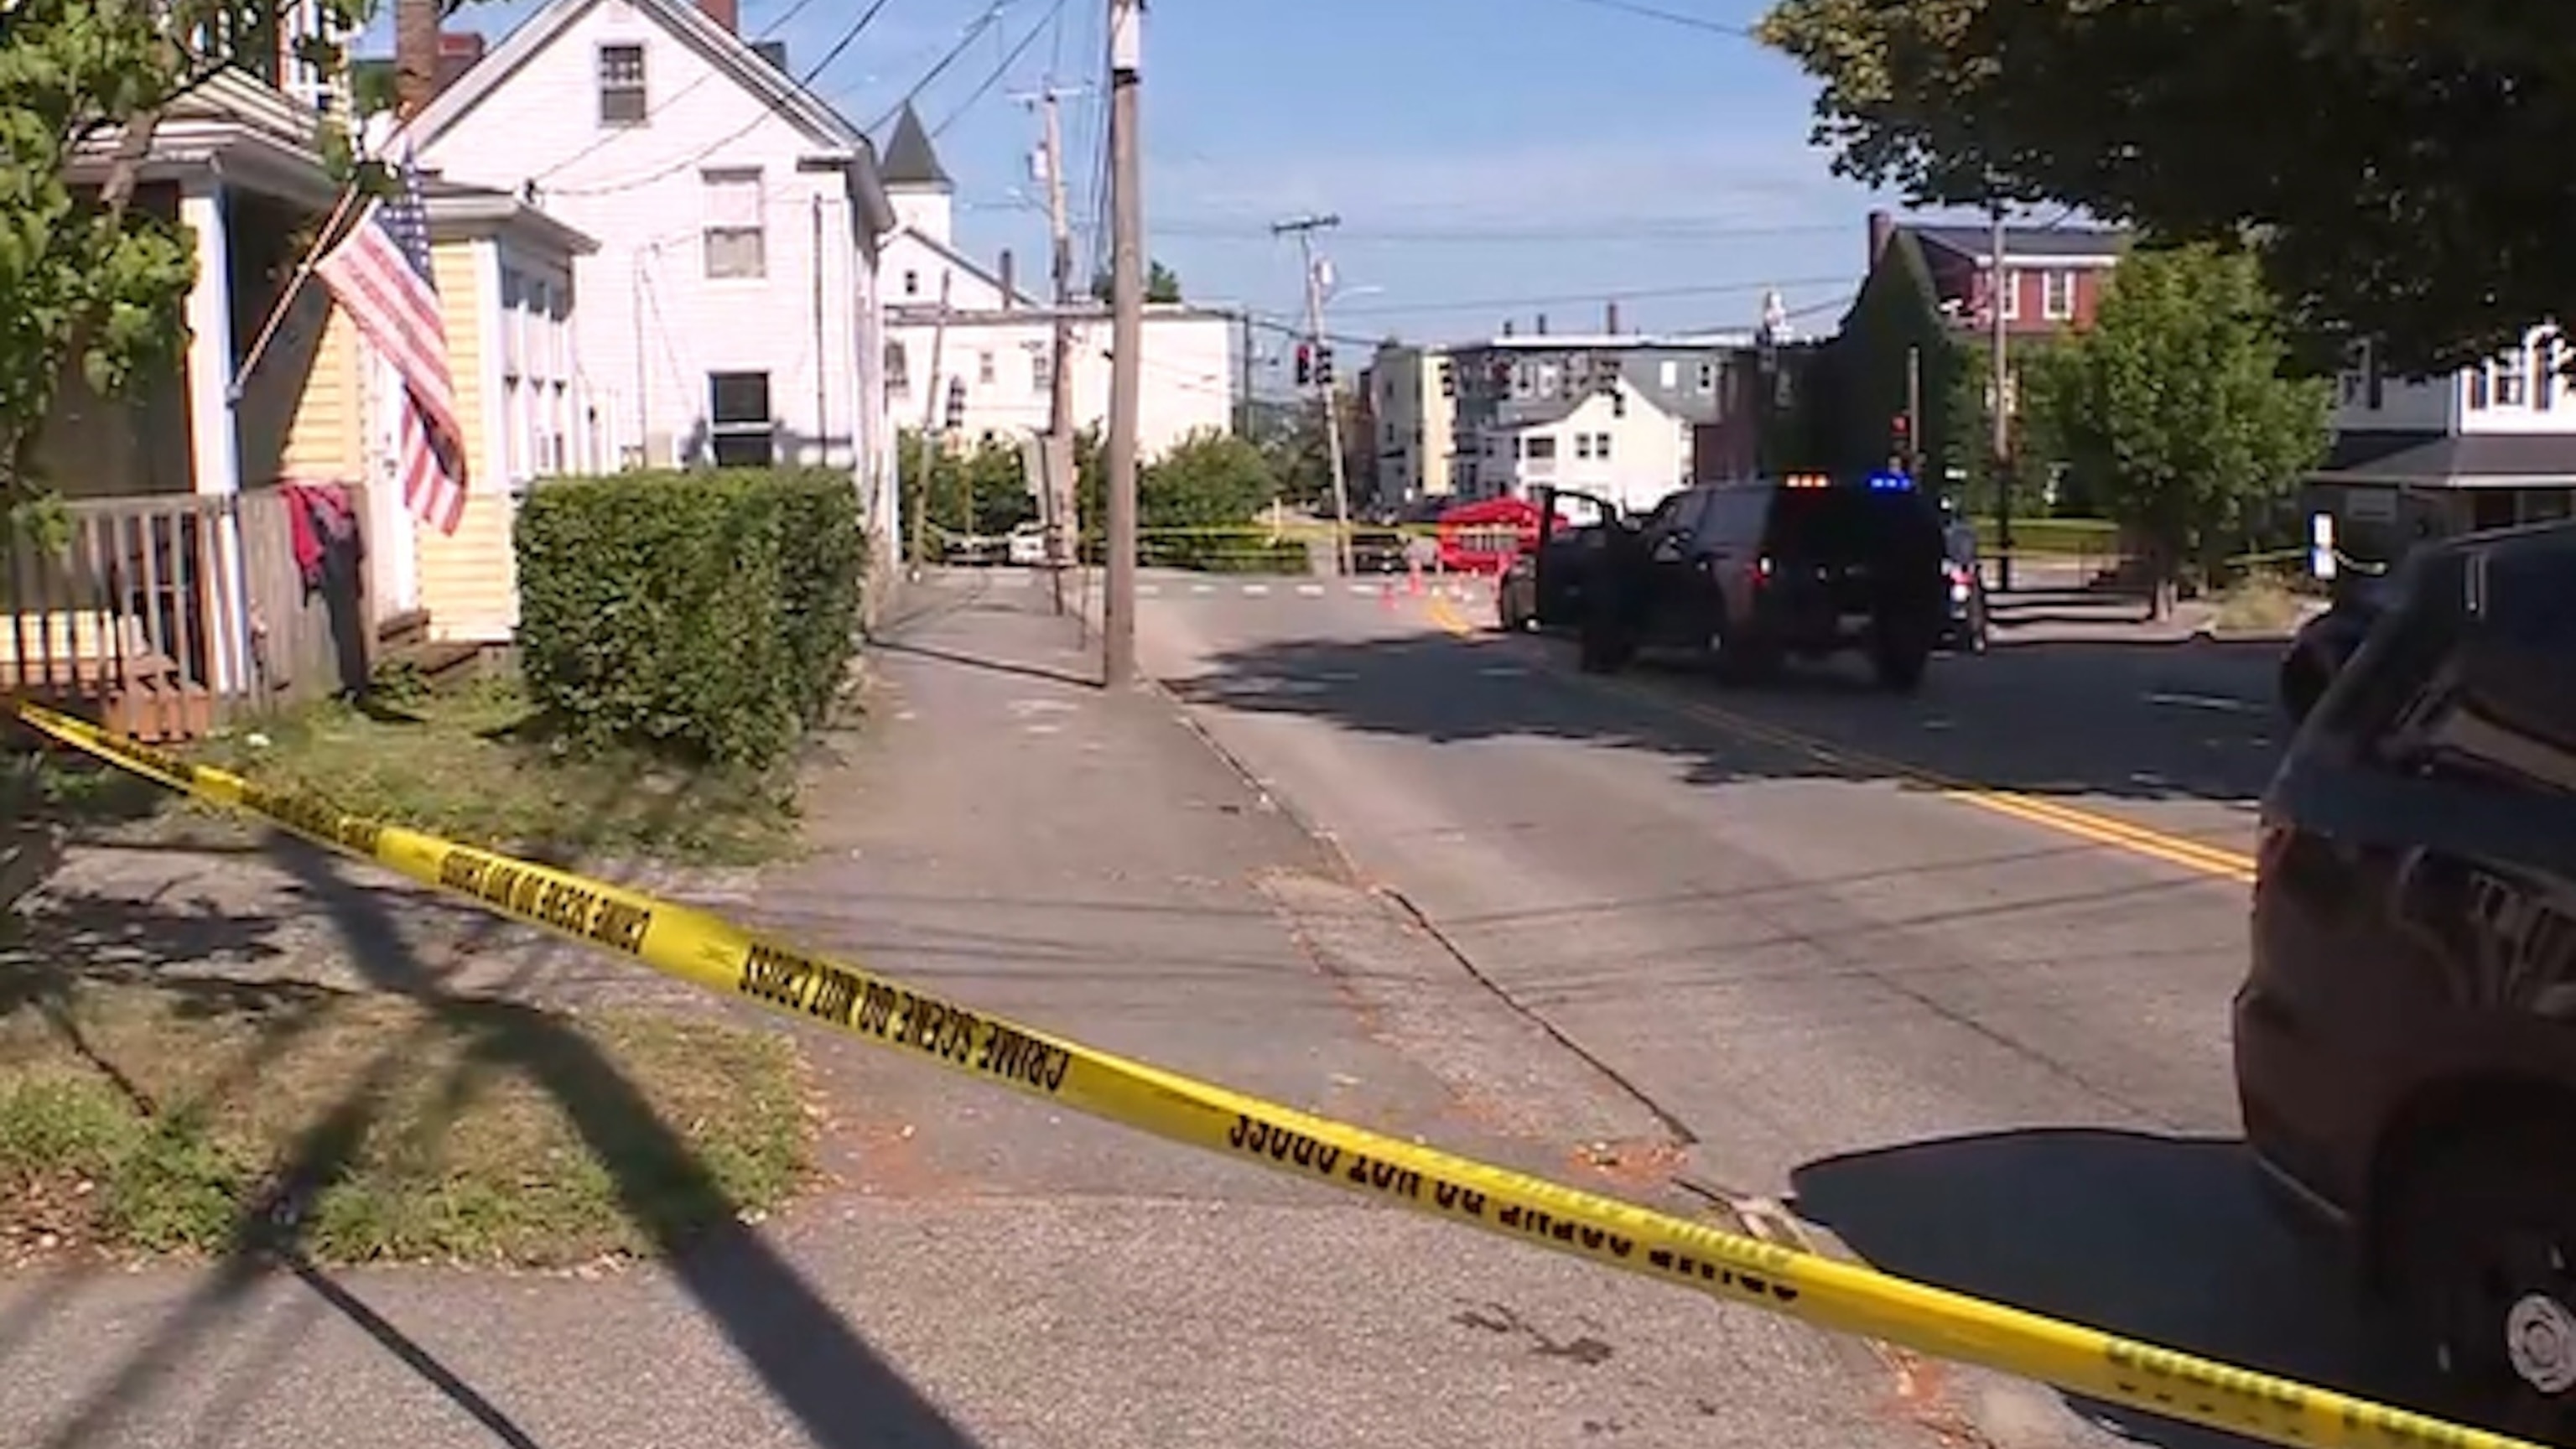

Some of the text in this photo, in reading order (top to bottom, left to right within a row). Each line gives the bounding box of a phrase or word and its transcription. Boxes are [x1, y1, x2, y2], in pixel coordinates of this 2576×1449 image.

[739, 945, 1070, 1093] CRIME SCENE DO NOT CROSS
